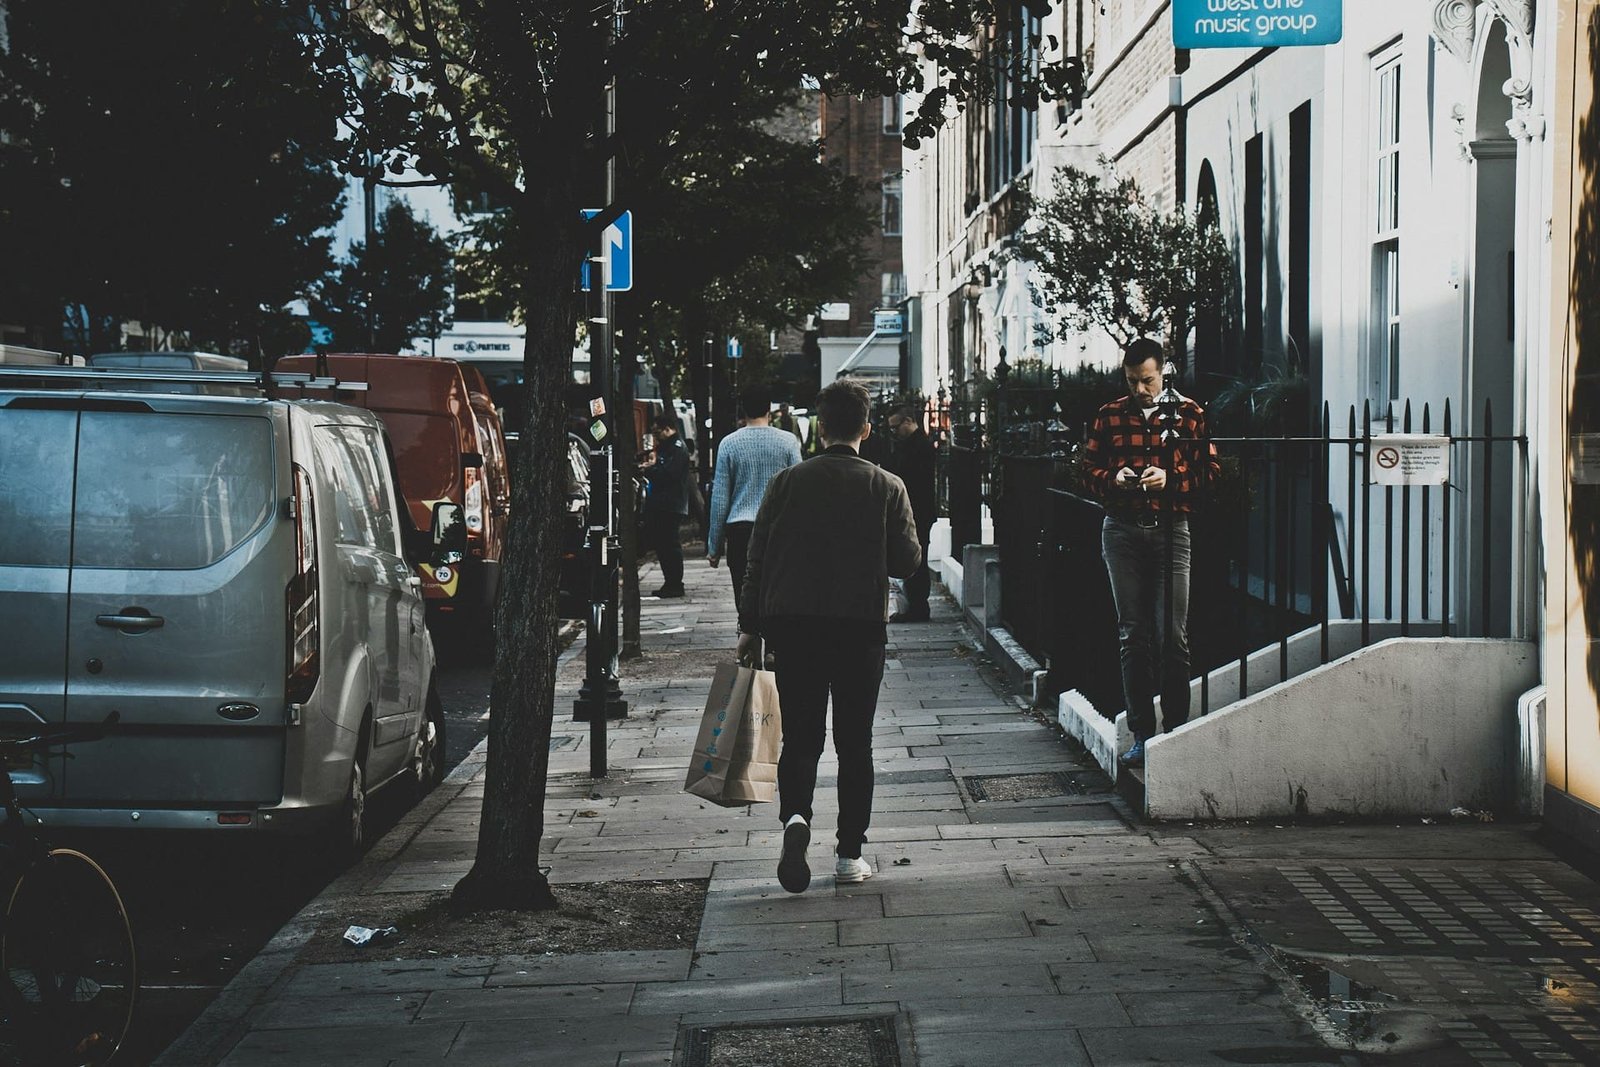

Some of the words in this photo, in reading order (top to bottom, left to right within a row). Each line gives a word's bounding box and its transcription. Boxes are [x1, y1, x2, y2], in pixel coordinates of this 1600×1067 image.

[1207, 0, 1259, 12] west
[1263, 0, 1302, 9] one
[1194, 13, 1250, 34] music
[1255, 14, 1317, 36] group
